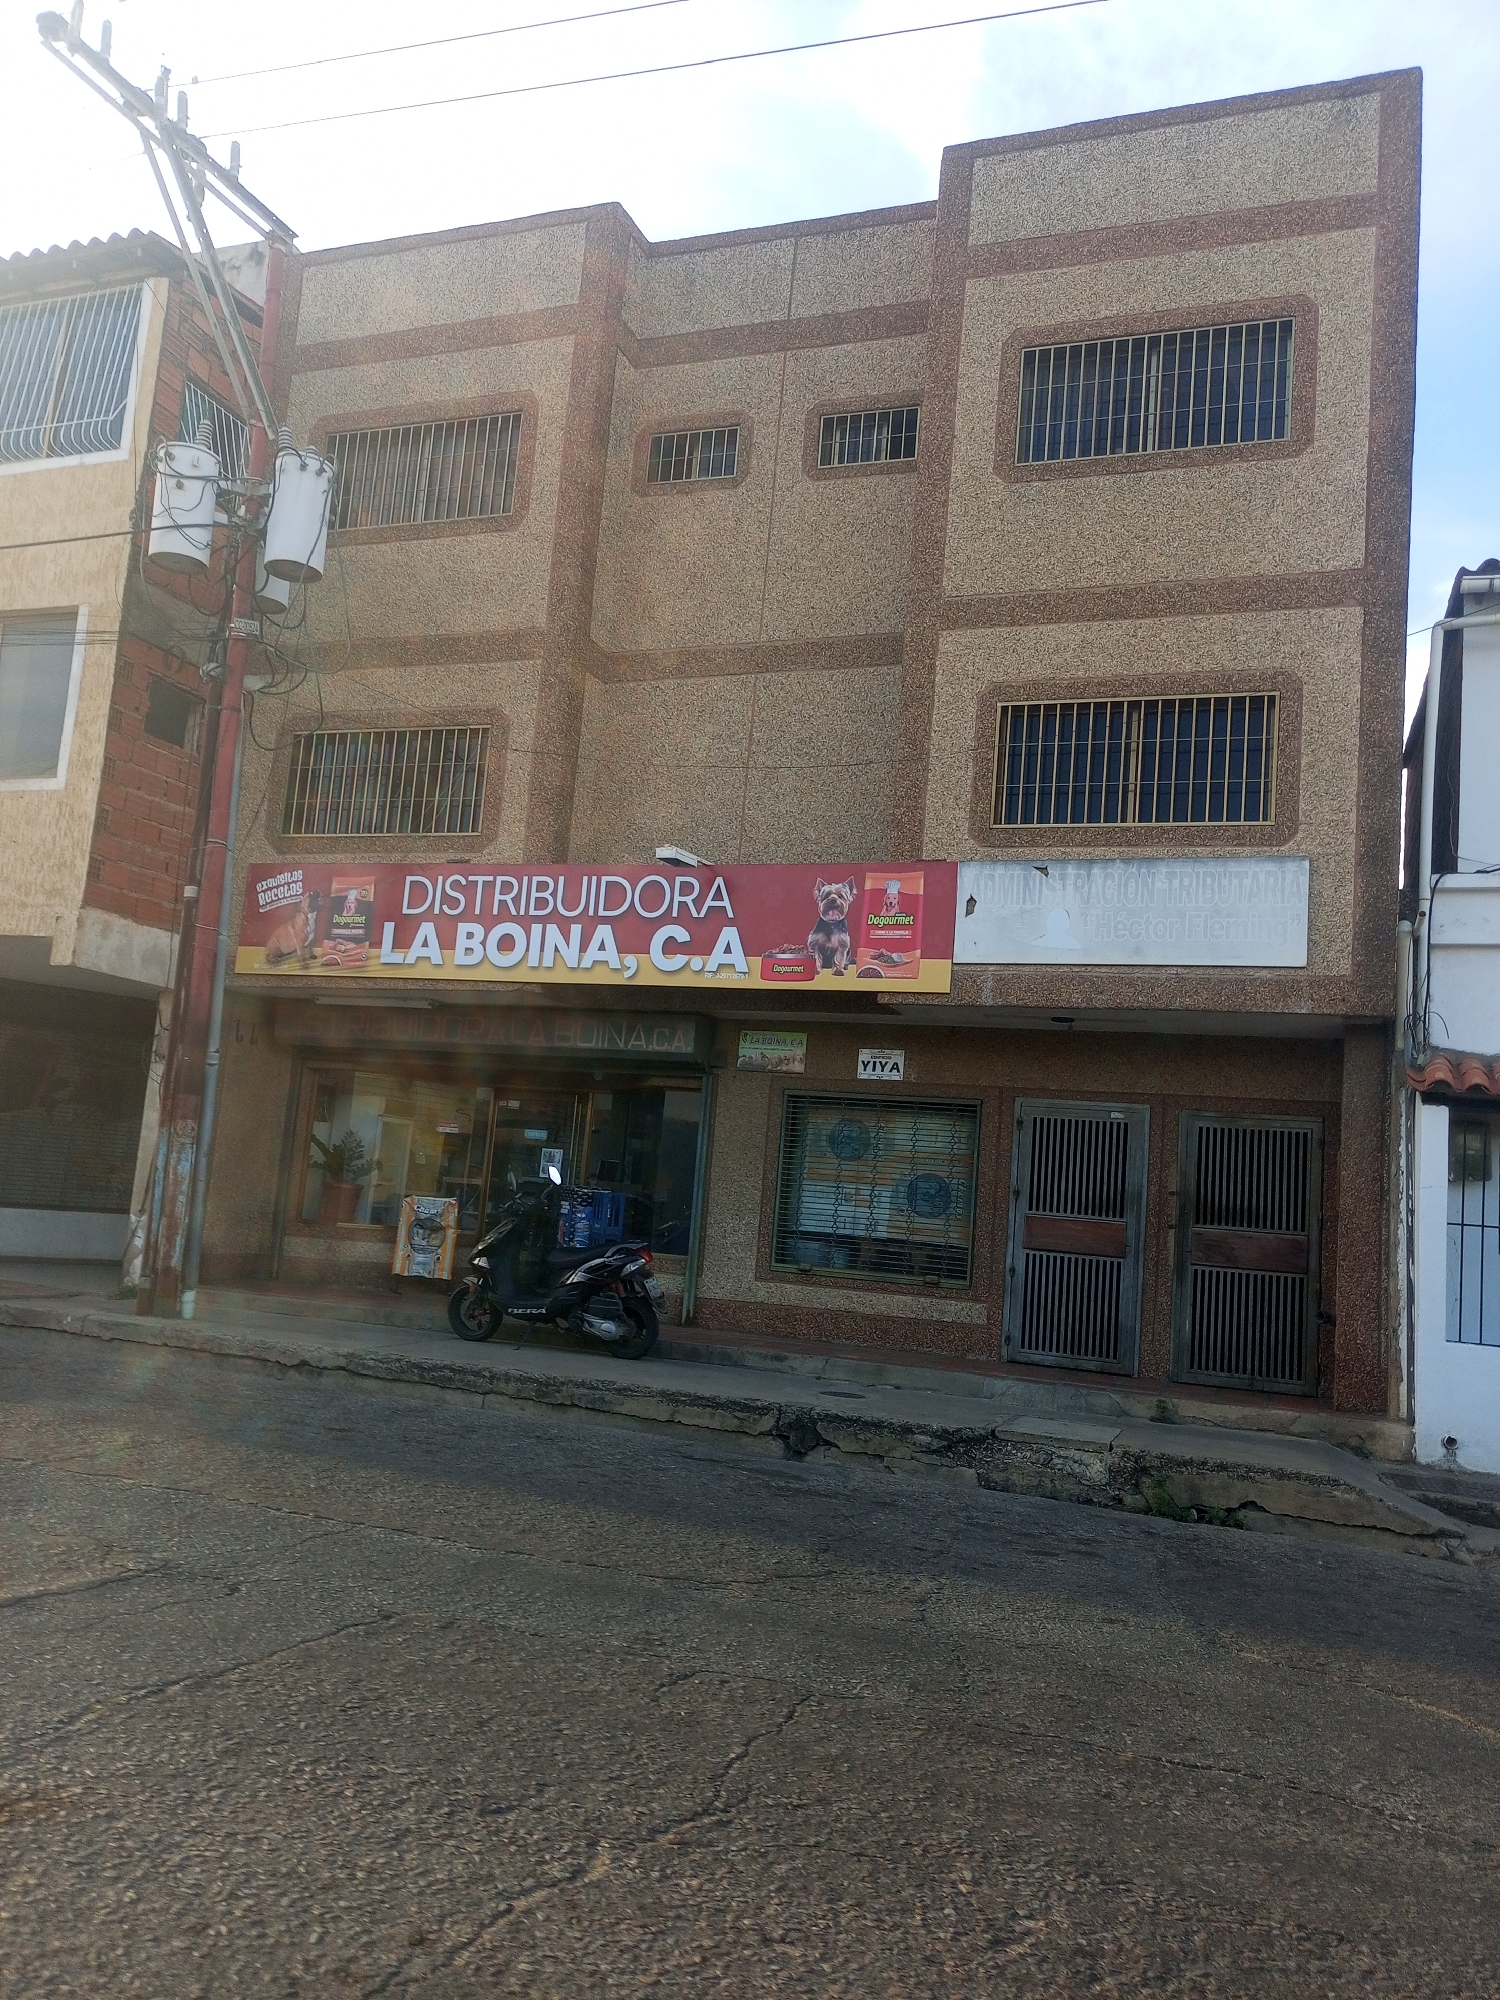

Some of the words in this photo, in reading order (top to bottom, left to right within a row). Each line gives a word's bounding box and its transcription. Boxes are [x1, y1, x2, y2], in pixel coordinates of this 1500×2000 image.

[1161, 868, 1305, 907] TRIBUTARIA
[402, 875, 734, 919] DISTRIBUIDORA
[332, 914, 366, 926] Dogourmet
[867, 913, 914, 928] Dogourmet
[380, 921, 444, 965] LA
[453, 921, 638, 979] BOINA,
[650, 924, 749, 973] C.A
[772, 964, 805, 974] Dogourmet
[861, 1060, 901, 1074] YIYA
